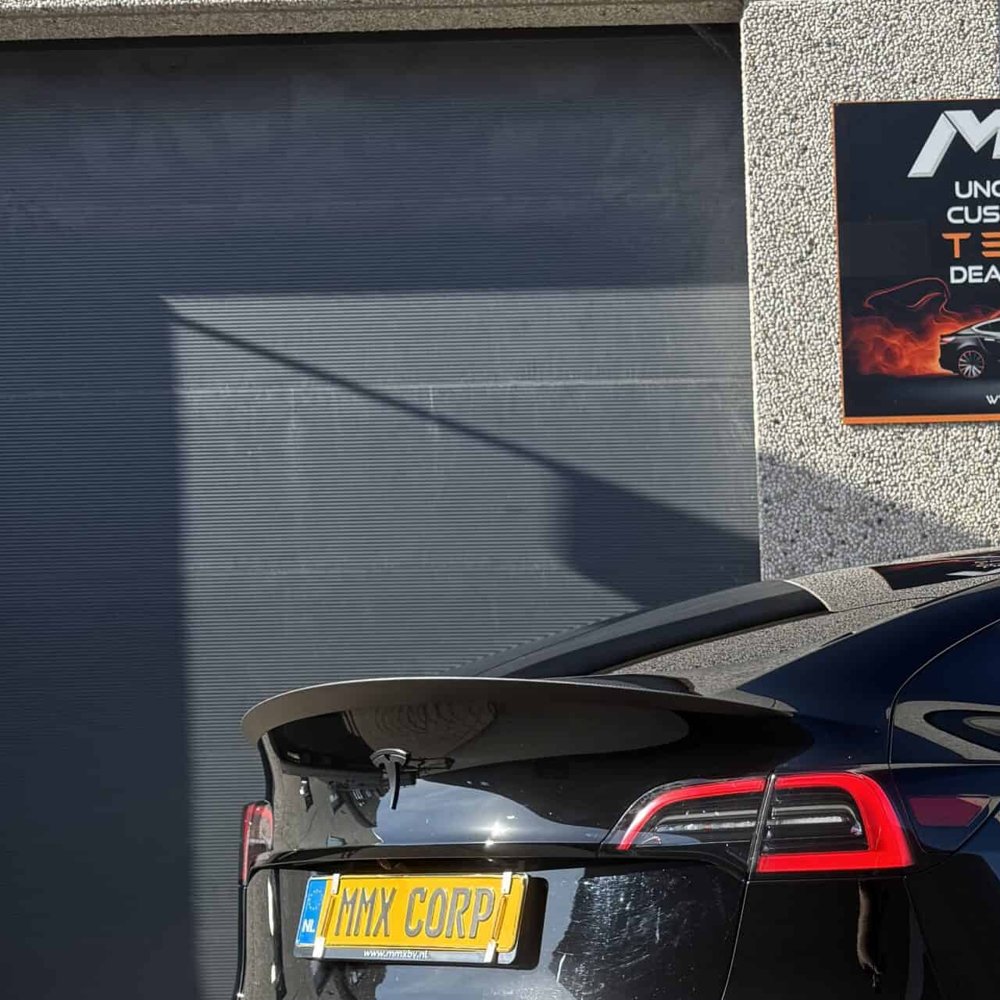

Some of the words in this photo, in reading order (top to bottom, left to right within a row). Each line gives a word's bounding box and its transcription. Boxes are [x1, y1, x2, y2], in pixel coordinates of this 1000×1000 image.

[334, 887, 397, 937] MMX
[404, 887, 495, 939] CORP
[301, 918, 315, 932] NL
[363, 949, 429, 960] www.mmxbv.nl
